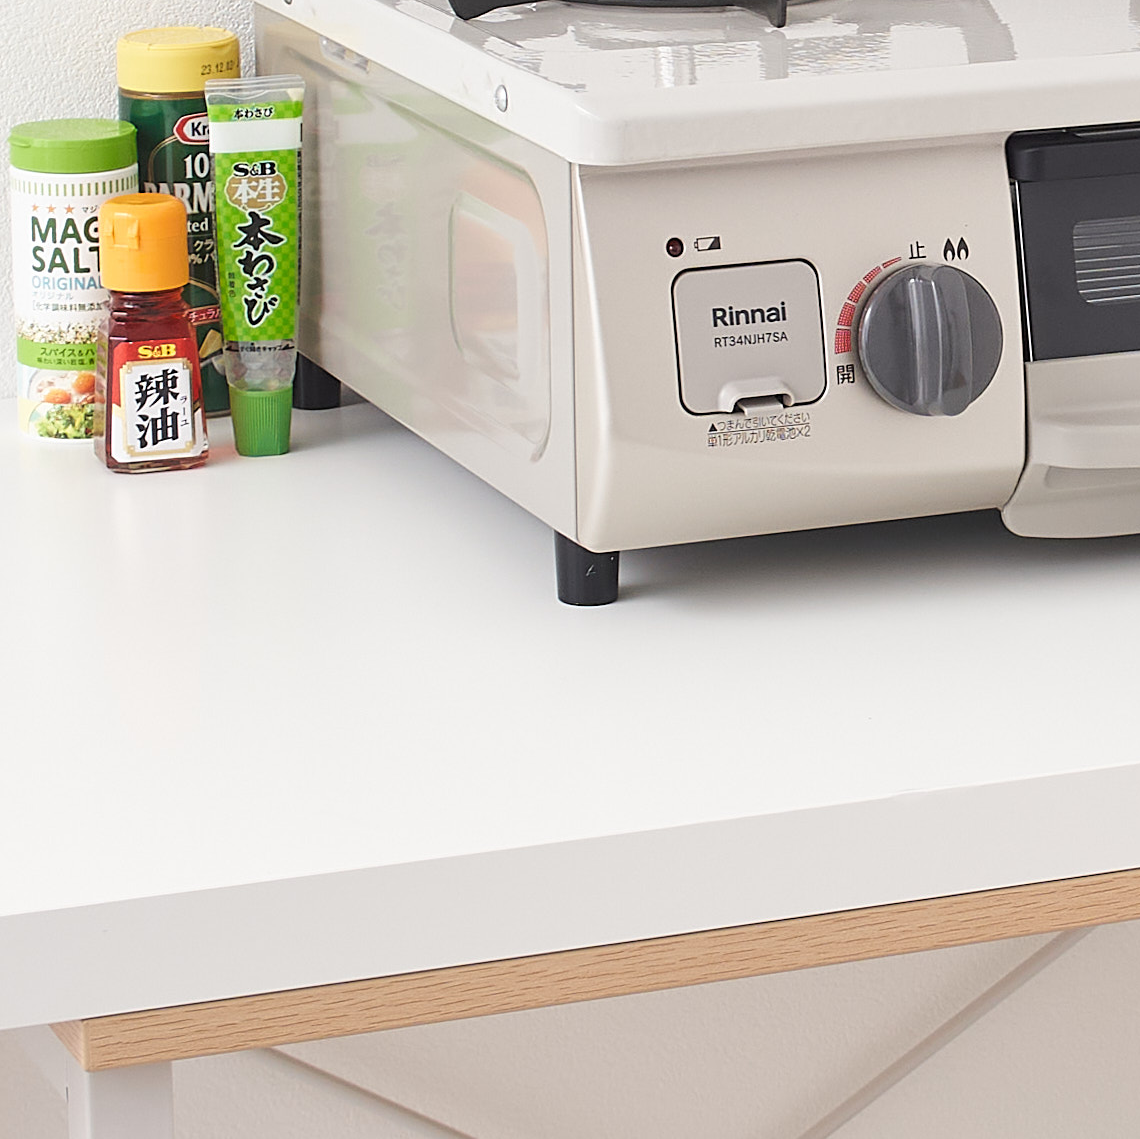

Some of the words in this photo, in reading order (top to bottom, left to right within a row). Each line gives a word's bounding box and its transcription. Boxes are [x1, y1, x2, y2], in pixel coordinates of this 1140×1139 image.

[234, 107, 273, 120] 本わさび
[191, 121, 210, 137] Kr
[233, 162, 277, 177] S&B
[231, 178, 281, 204] 本生
[31, 245, 100, 274] SALT
[909, 240, 927, 260] 止
[233, 211, 285, 327] 本わさび
[711, 300, 787, 328] Rinnai
[713, 331, 788, 348] RT34NJH7SA
[137, 343, 177, 359] S&B
[837, 364, 855, 385] 開
[135, 369, 180, 449] 辣油
[180, 395, 190, 427] ラーユ
[716, 412, 811, 432] つまんで引いてください
